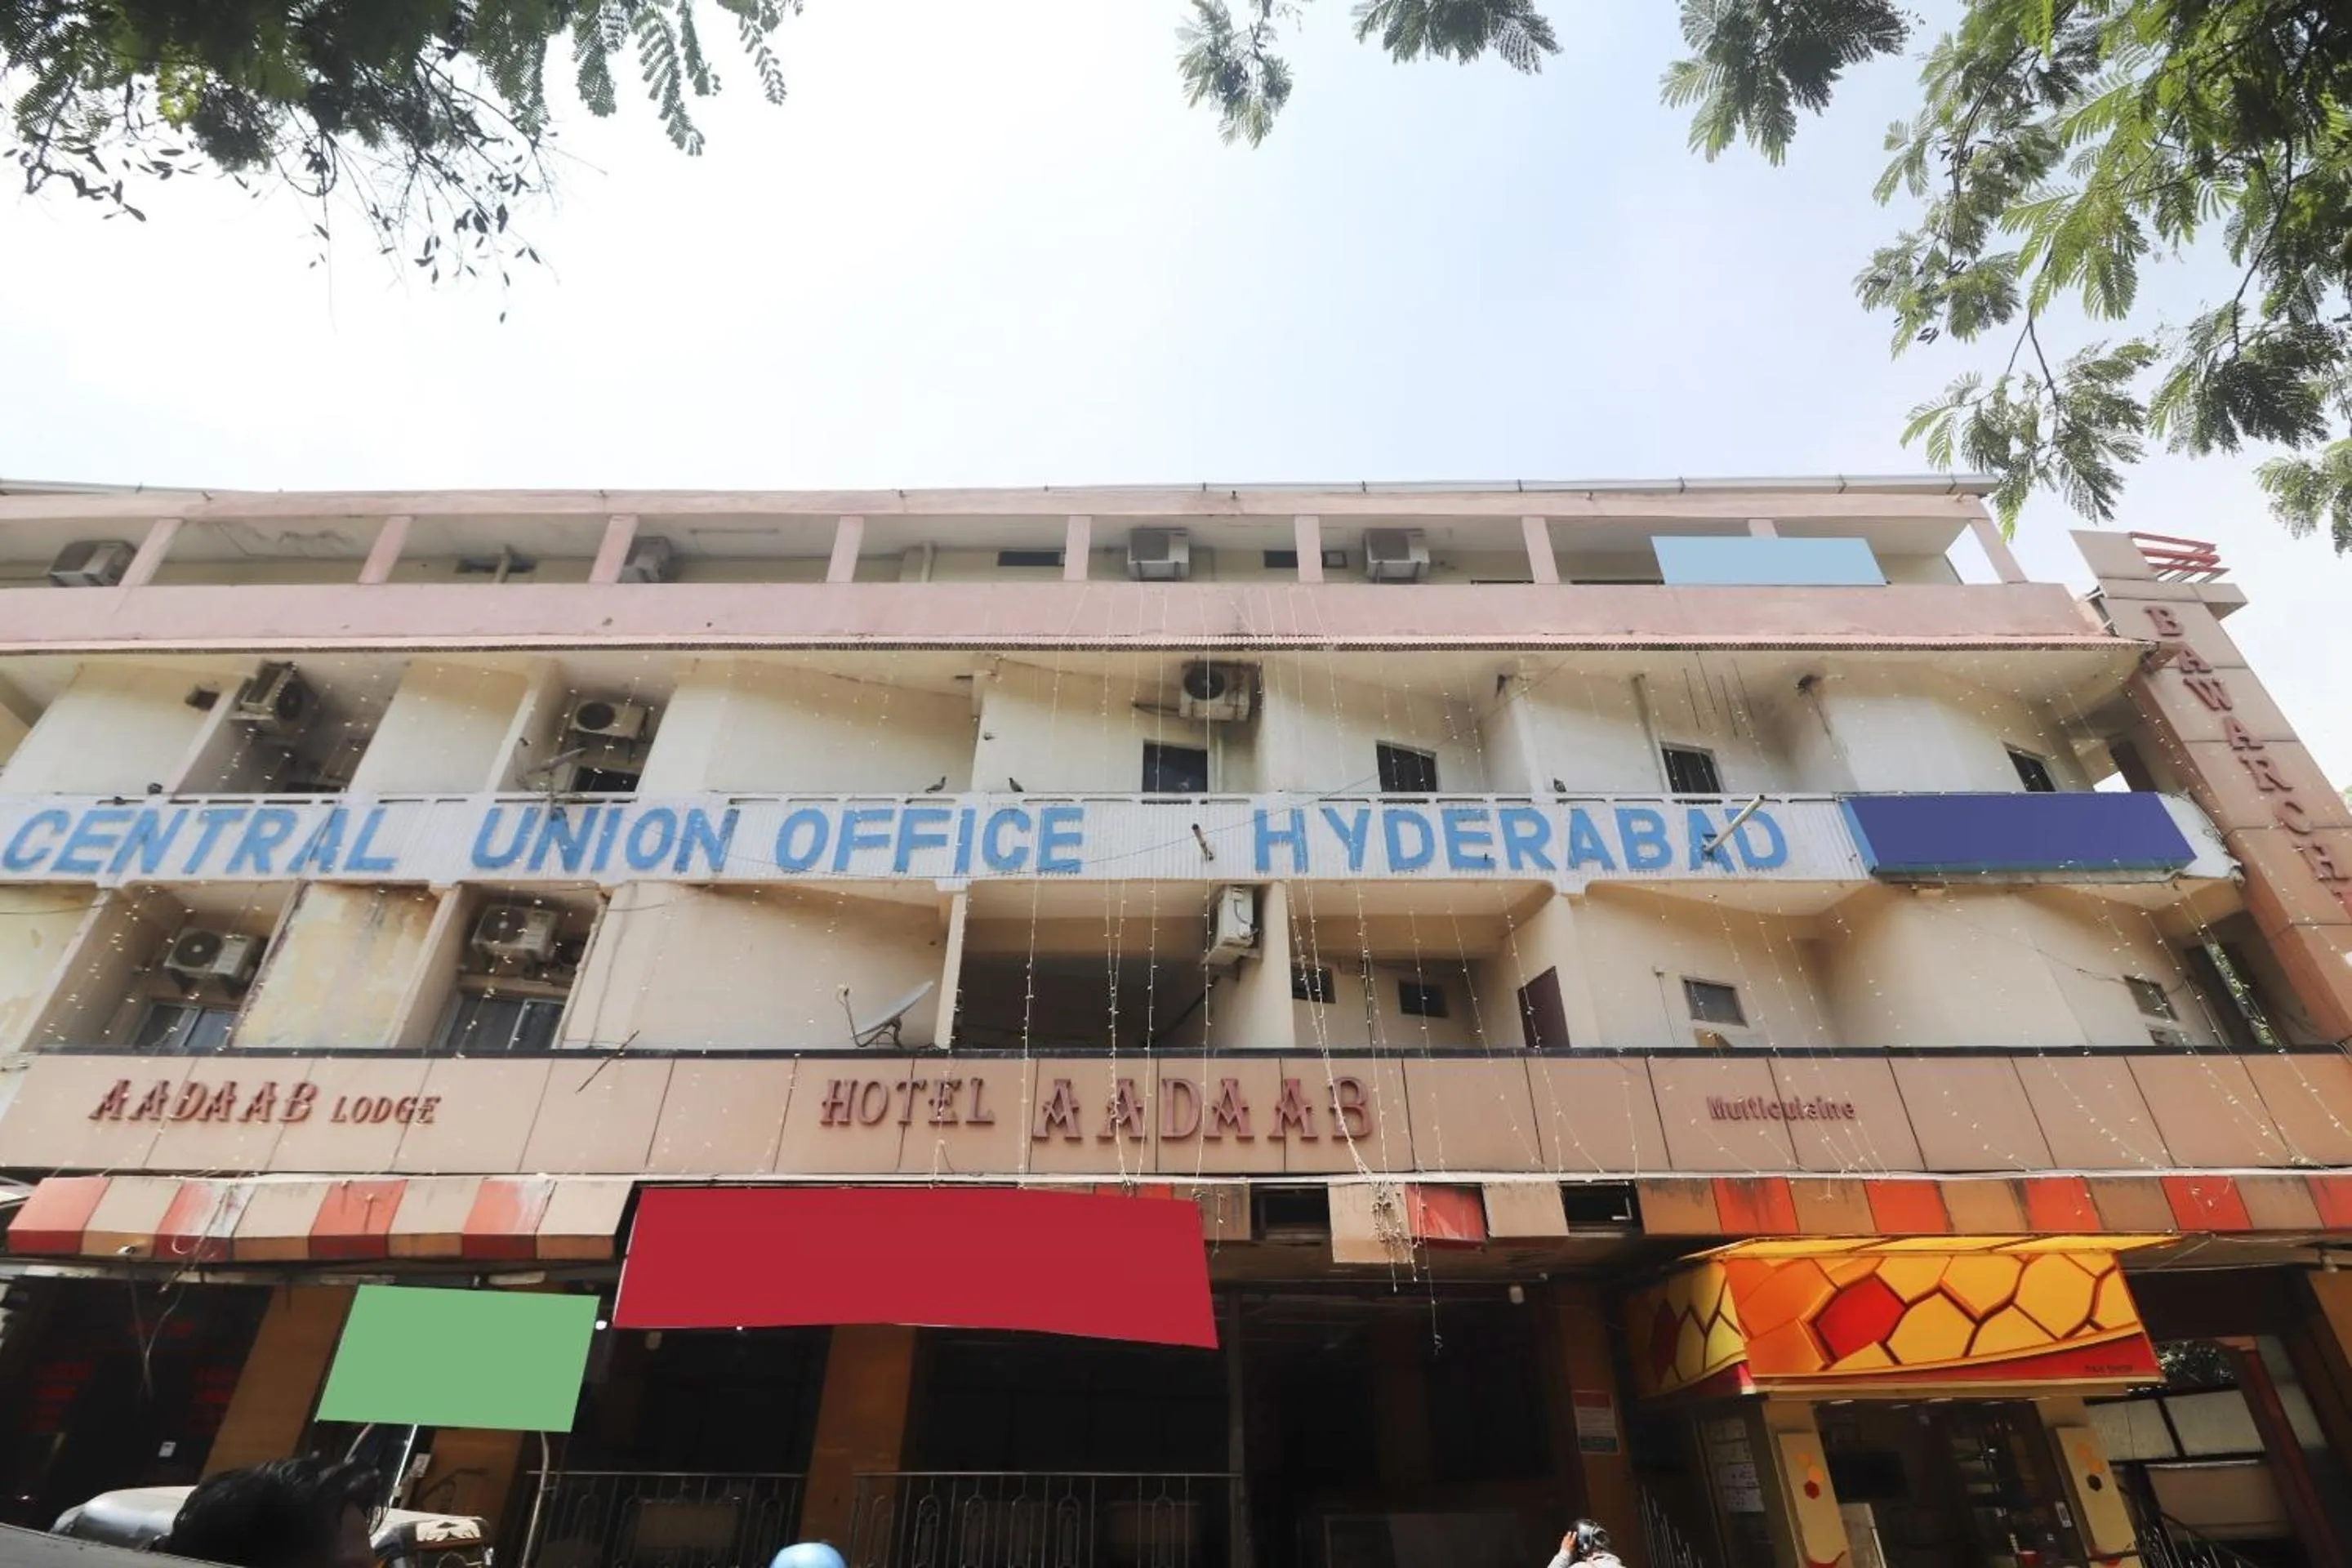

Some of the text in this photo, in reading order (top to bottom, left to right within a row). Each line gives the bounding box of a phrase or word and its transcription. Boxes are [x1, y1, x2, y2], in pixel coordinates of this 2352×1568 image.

[2, 804, 1788, 875] CENTRAL UNION OFFICE HYDERABAD
[88, 1077, 442, 1125] AADAAB LODGE
[819, 1076, 1374, 1143] HOTEL AADAAB
